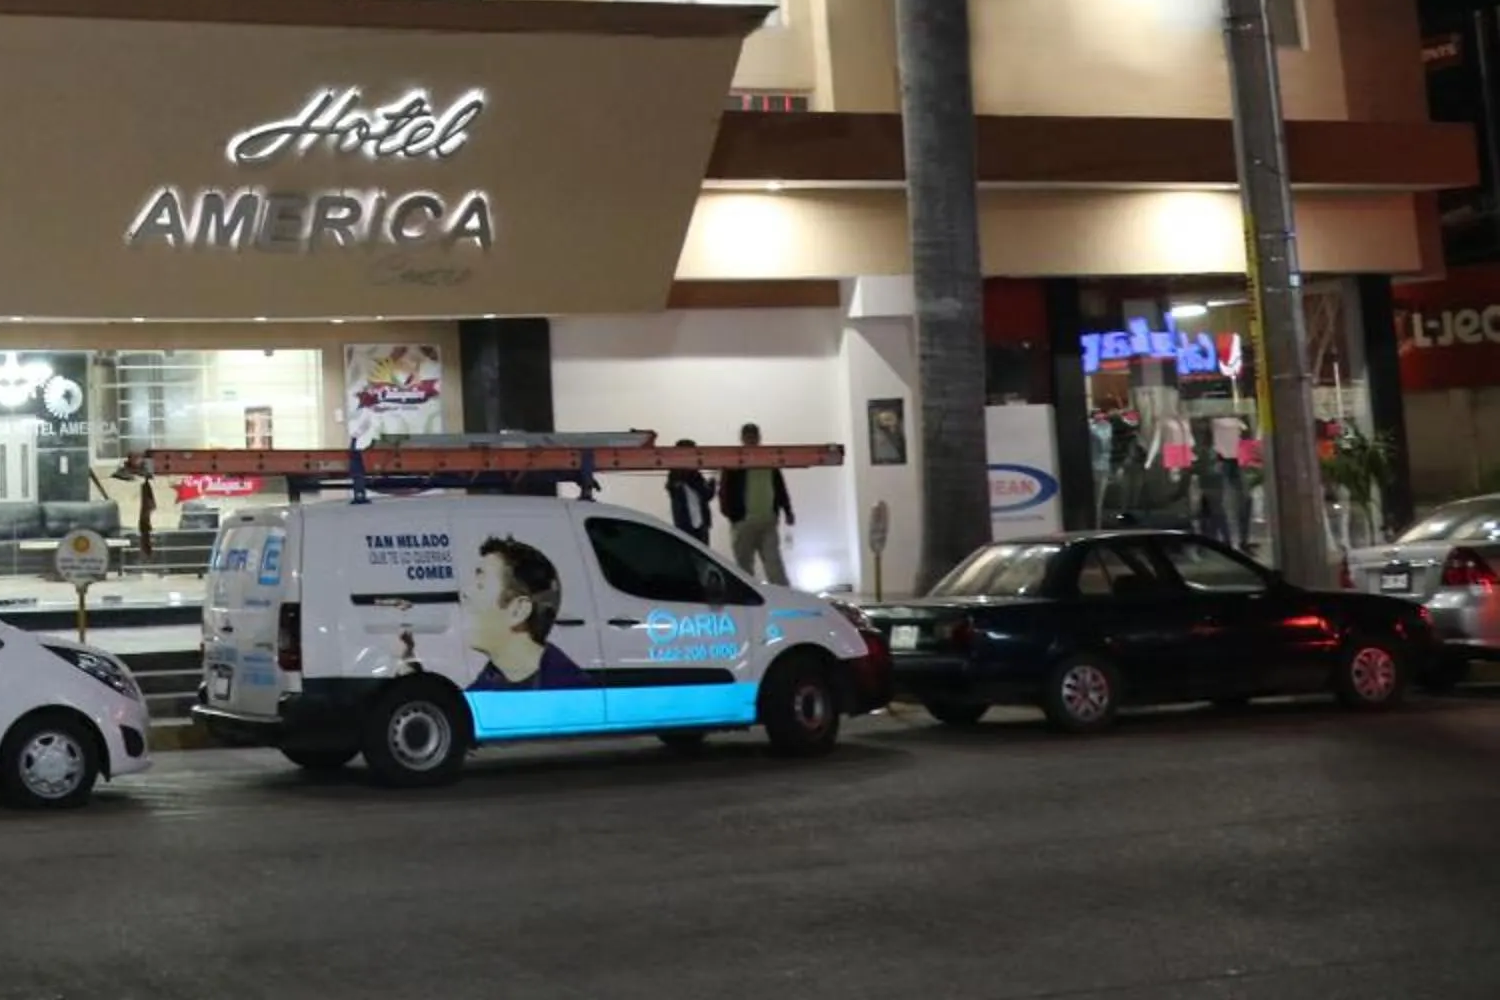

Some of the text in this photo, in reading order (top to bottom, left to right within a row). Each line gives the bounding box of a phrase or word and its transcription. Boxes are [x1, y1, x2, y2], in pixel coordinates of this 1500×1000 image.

[226, 86, 486, 164] Hotel
[124, 184, 494, 252] AMERICA
[59, 421, 119, 437] AMECA
[365, 533, 450, 549] TAN HELADO
[406, 565, 454, 580] COMER
